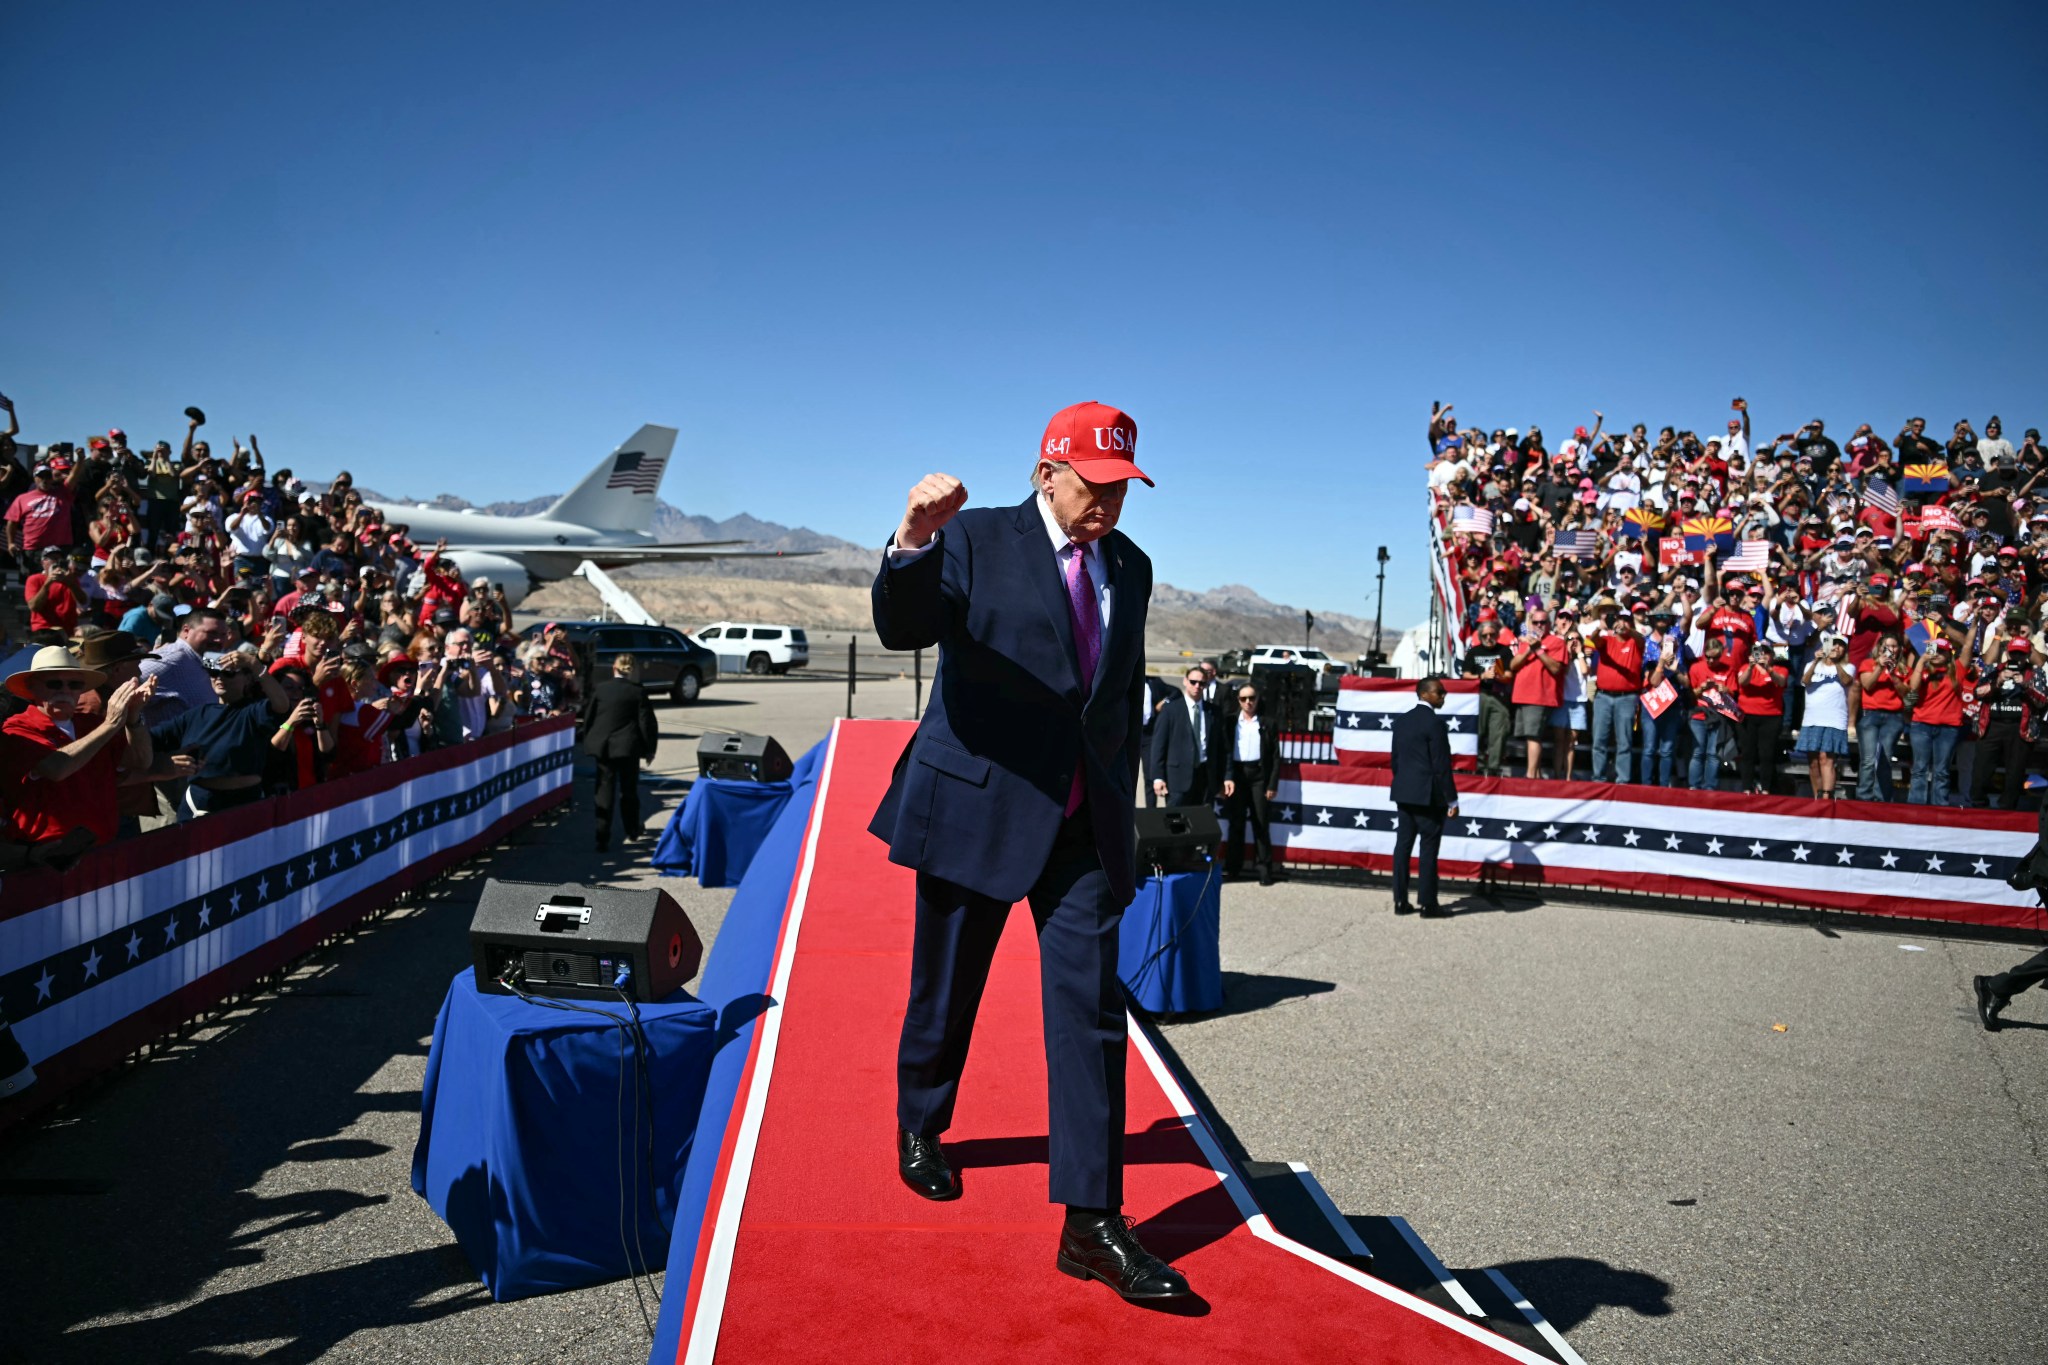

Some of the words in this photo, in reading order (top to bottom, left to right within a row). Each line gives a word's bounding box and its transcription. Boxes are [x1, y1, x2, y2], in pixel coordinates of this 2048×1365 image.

[1093, 427, 1135, 453] USA
[1045, 437, 1071, 455] 45-47
[1925, 508, 1942, 516] NO
[1945, 510, 1957, 519] TA
[1662, 540, 1680, 550] NO
[1670, 552, 1694, 562] TIPS
